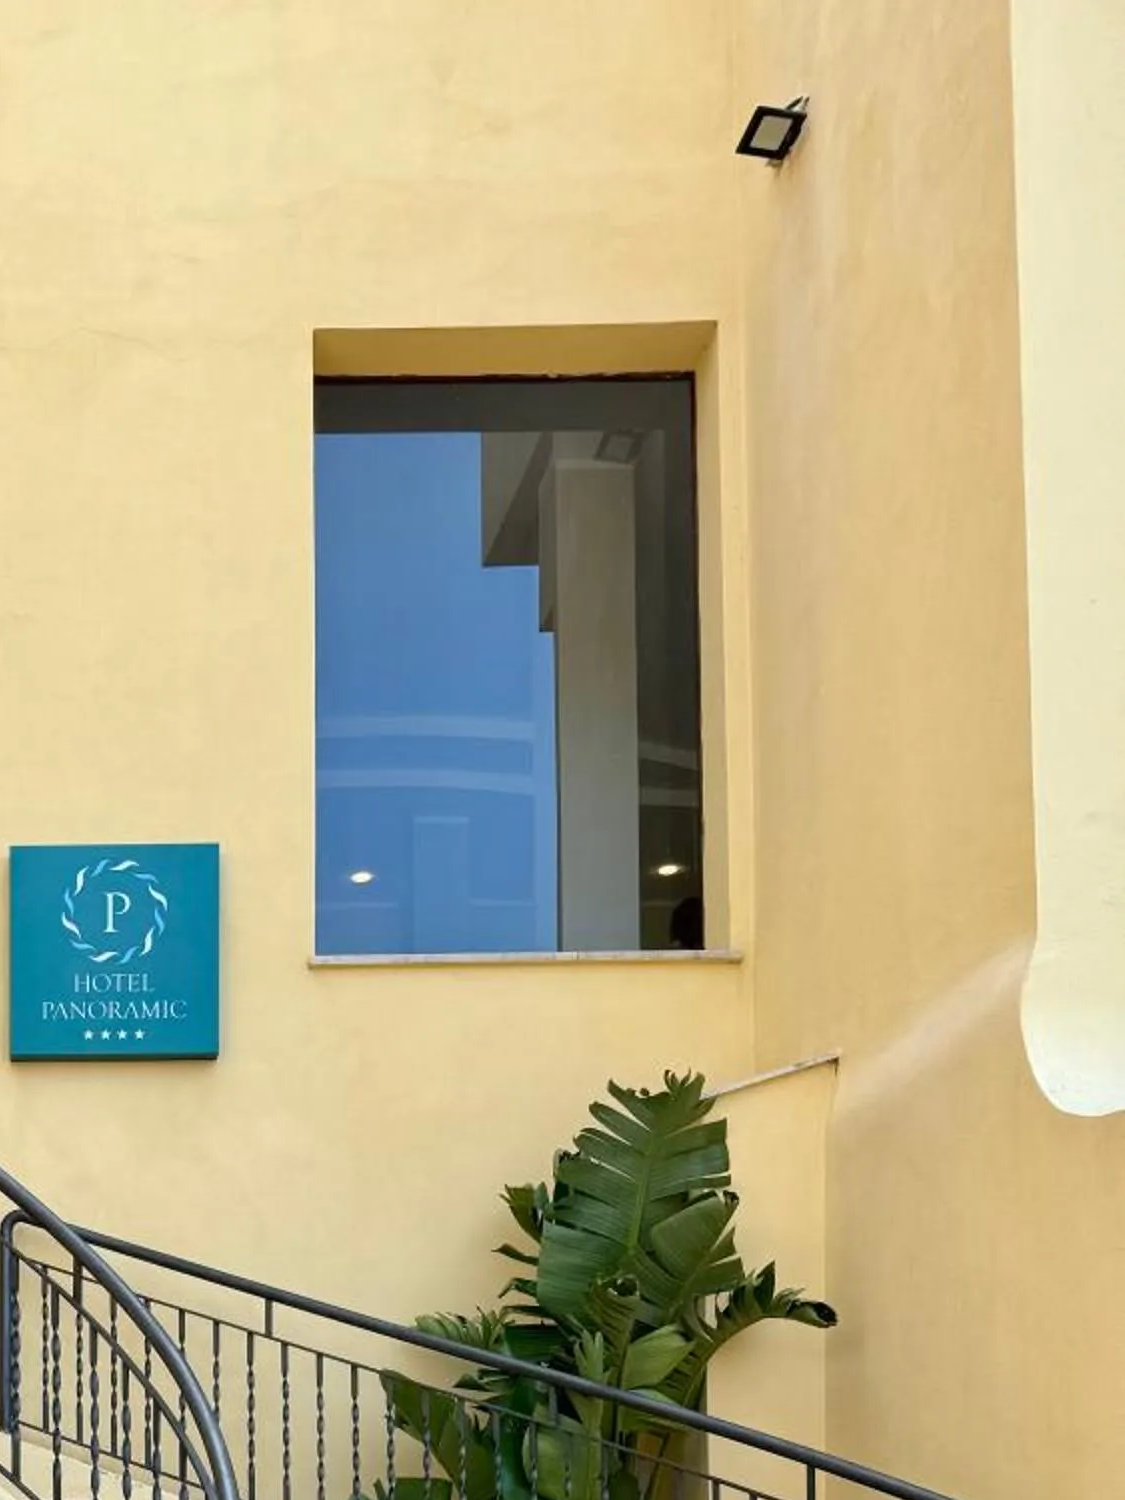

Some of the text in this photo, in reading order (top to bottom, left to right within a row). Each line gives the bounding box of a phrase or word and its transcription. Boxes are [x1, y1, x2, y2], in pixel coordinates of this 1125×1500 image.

[103, 891, 131, 933] P
[74, 973, 155, 993] HOTEL
[41, 999, 188, 1020] PANORAMIC
